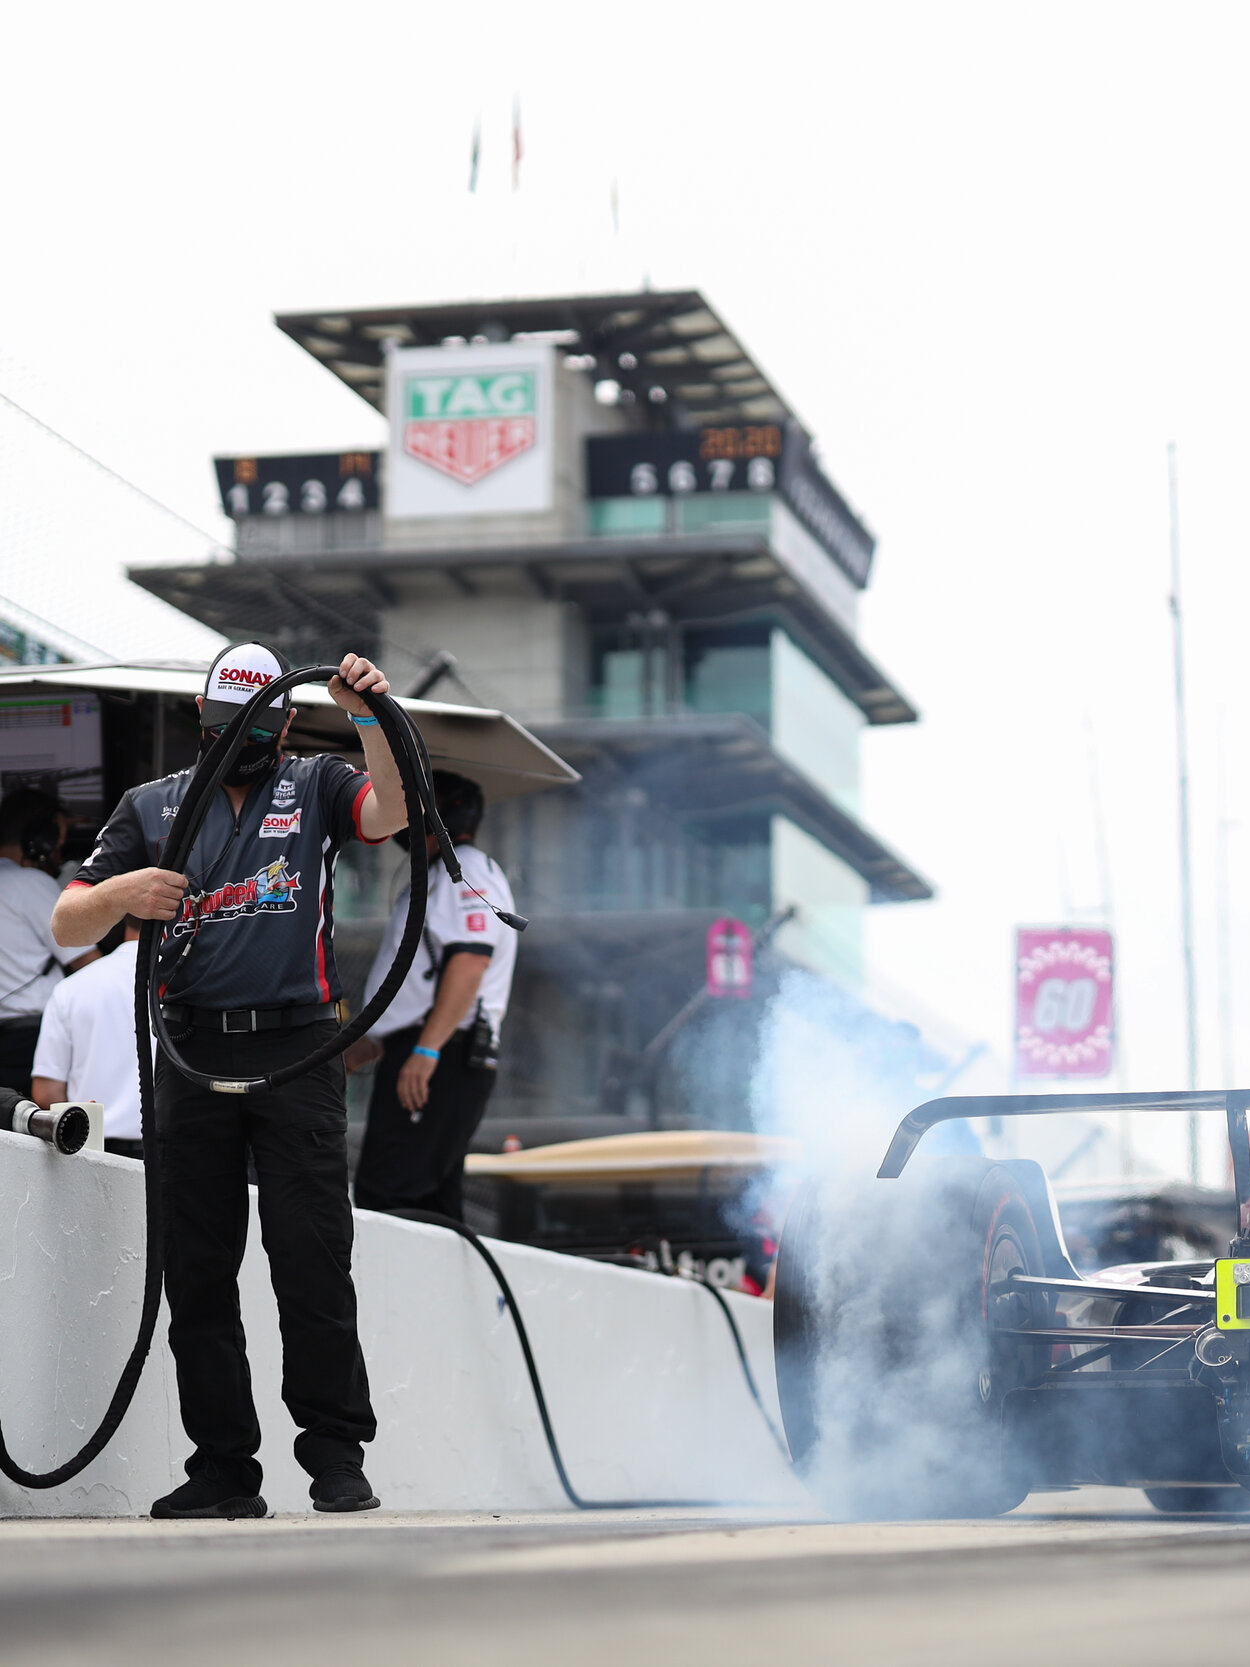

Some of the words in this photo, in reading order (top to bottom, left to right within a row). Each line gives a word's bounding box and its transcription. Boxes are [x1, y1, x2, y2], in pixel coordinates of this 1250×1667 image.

[414, 374, 527, 416] TAG
[630, 462, 658, 494] 5
[668, 460, 697, 493] 6
[707, 458, 735, 491] 7
[747, 456, 775, 490] 8
[226, 483, 249, 515] 1
[262, 481, 290, 515] 2
[300, 478, 328, 514] 3
[335, 476, 366, 511] 4
[218, 667, 275, 687] SONAX
[1033, 977, 1099, 1032] 60
